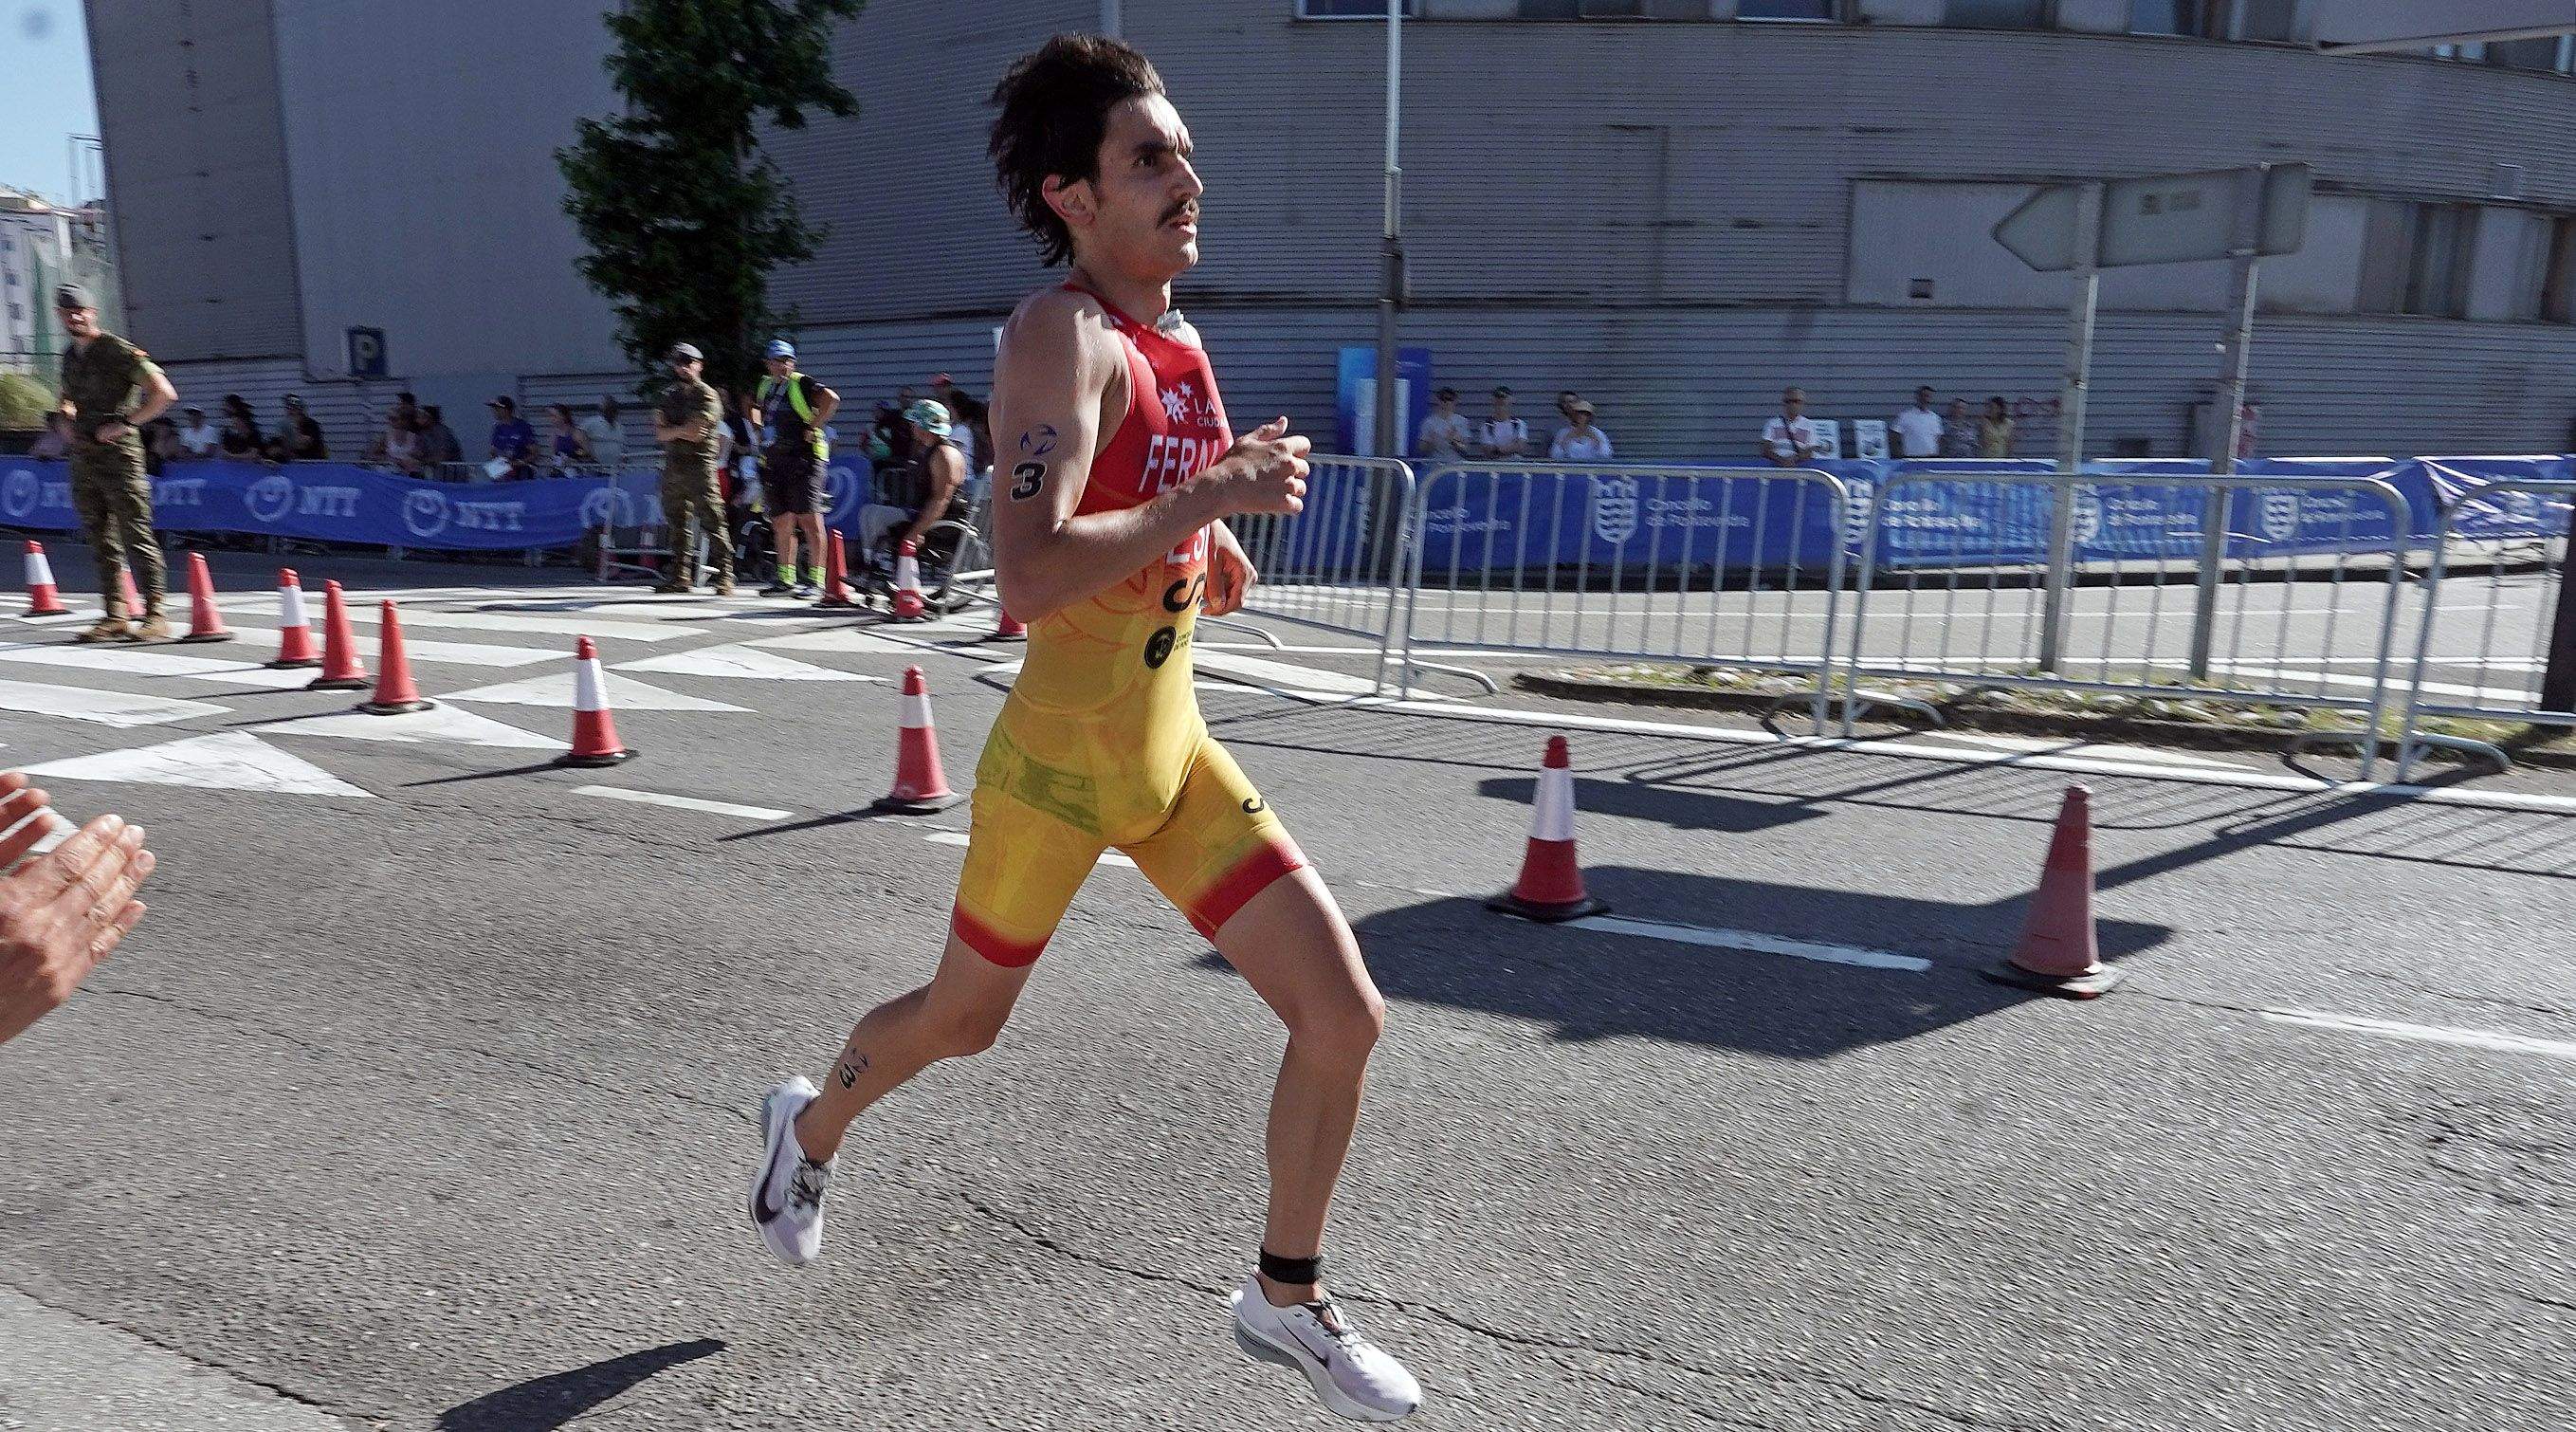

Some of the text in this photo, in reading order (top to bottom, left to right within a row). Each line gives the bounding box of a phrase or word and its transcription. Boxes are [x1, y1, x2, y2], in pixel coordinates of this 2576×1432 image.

[356, 334, 377, 373] P
[1194, 397, 1216, 414] LA
[1010, 461, 1047, 502] 3
[298, 486, 360, 517] NTT
[453, 501, 523, 531] NTT
